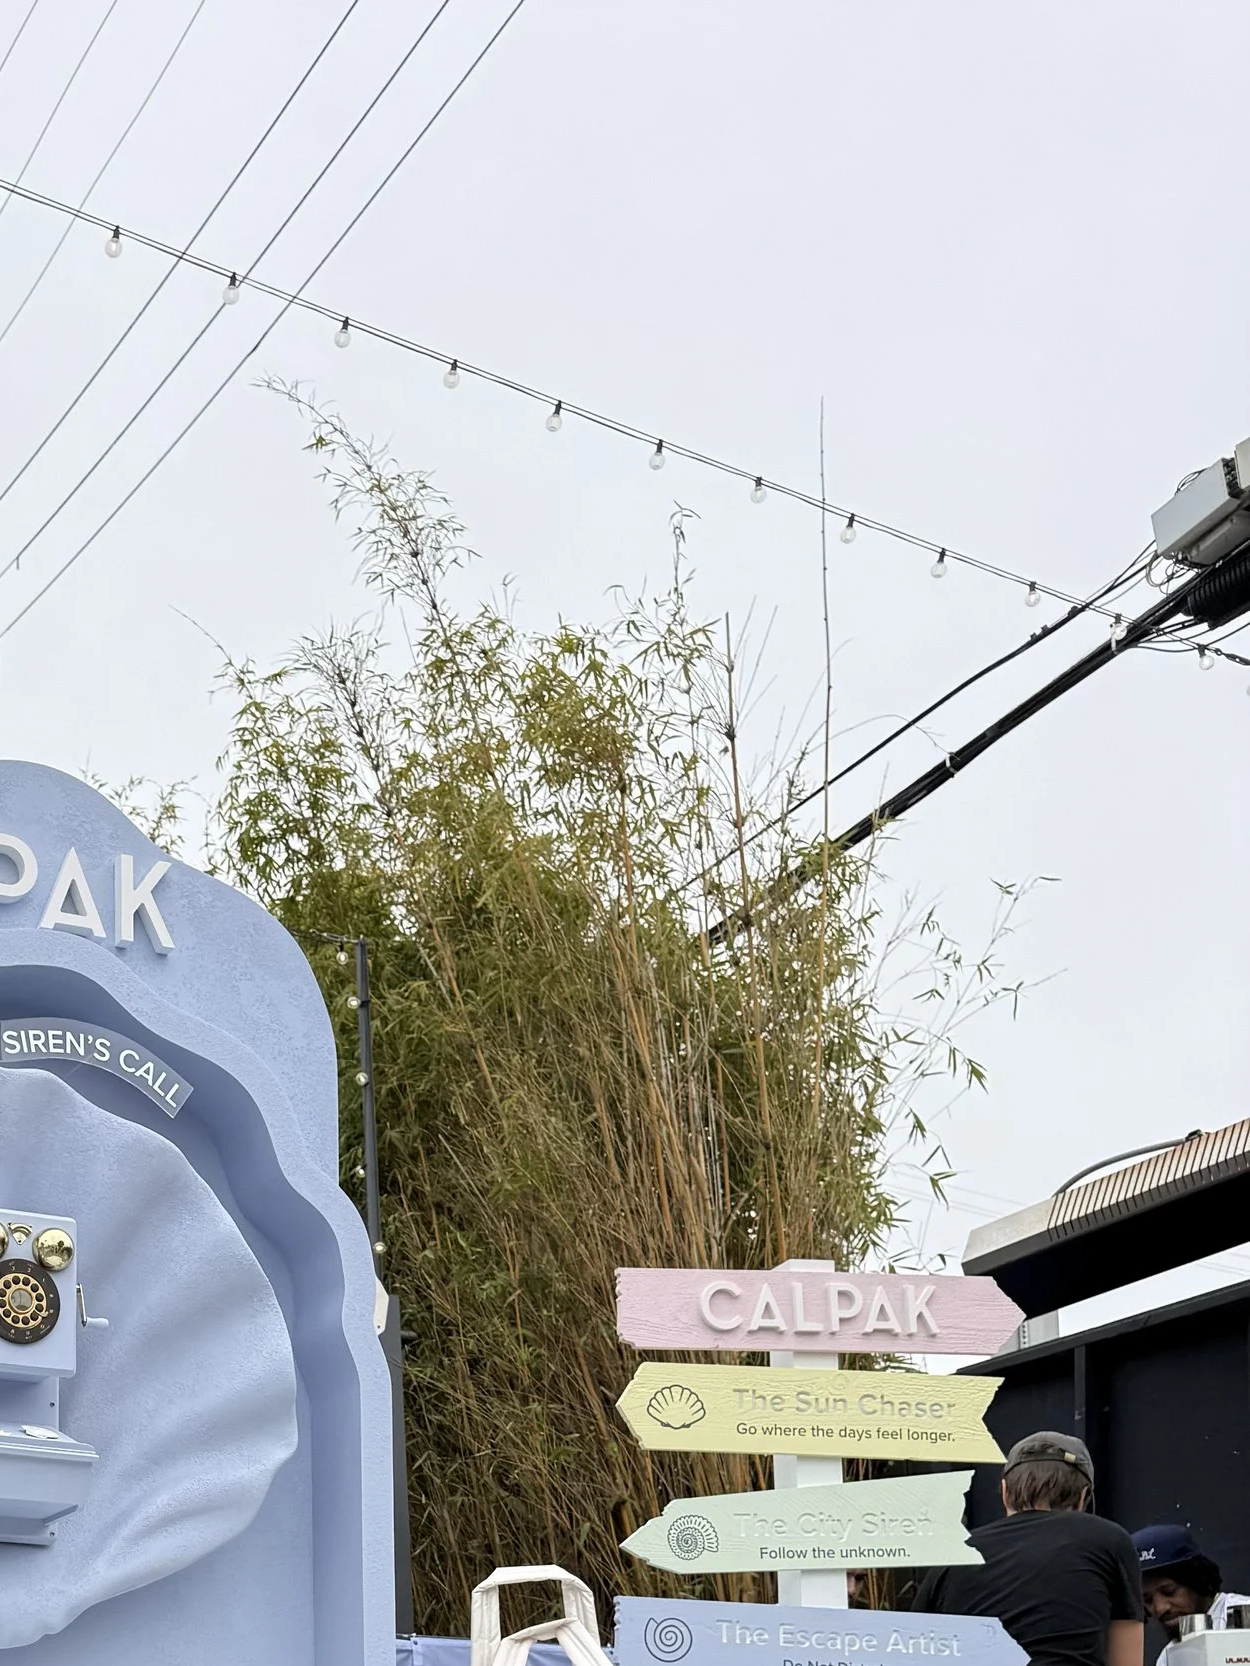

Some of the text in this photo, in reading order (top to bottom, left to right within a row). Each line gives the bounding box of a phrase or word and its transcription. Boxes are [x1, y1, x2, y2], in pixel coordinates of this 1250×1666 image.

[2, 1026, 112, 1062] SIREN'S
[119, 1049, 180, 1108] CALL
[700, 1281, 941, 1337] CALPAK
[732, 1387, 956, 1420] The Sun Chaser
[736, 1422, 956, 1445] Go where the days feel longer.
[733, 1511, 934, 1543] The City Siren
[759, 1546, 911, 1559] Follow the unknown.
[715, 1619, 962, 1657] The Escape Artist
